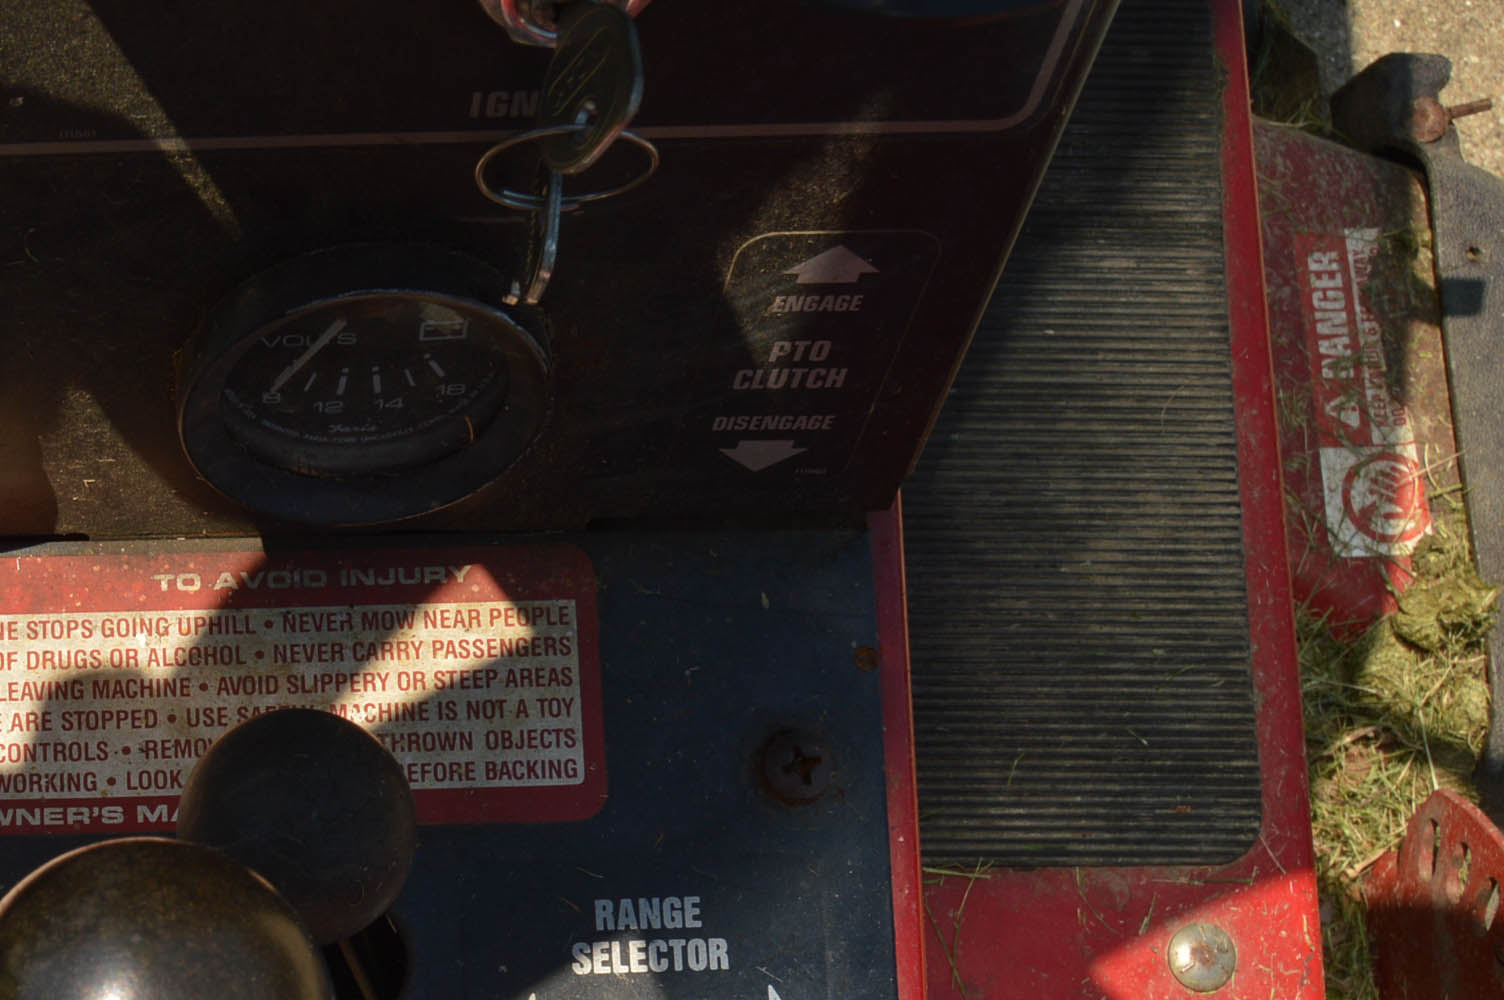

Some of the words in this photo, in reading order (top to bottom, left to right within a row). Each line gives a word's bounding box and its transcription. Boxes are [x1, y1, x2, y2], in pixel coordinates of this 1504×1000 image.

[772, 293, 864, 312] ENGAGE
[1307, 250, 1355, 379] DANGER
[768, 340, 832, 363] PTO
[732, 368, 848, 390] CLUTCH
[313, 401, 344, 413] 12
[373, 398, 404, 410] 14
[712, 415, 838, 431] DISENGAGE
[154, 572, 200, 591] TO
[213, 569, 326, 591] AVOID
[340, 565, 472, 587] INJURY
[26, 619, 94, 641] STOPS
[101, 616, 171, 638] GOING
[178, 615, 256, 637] UPHILL
[282, 610, 353, 633] NEVER
[362, 610, 415, 632] MOW
[423, 608, 481, 630] NEAR
[489, 605, 570, 628] PEOPLE
[26, 648, 102, 671] DRUGS
[110, 648, 139, 669] OR
[147, 645, 248, 668] ALCOHOL
[272, 641, 345, 664] NEVER
[353, 640, 424, 661] CARRY
[432, 636, 572, 660] PASSENGERS
[92, 677, 191, 700] MACHINE
[217, 675, 279, 697] AVOID
[286, 671, 390, 695] SLIPPERY
[397, 670, 426, 692] OR
[434, 668, 499, 690] STEEP
[505, 667, 573, 689] AREAS
[10, 711, 52, 733] ARE
[61, 708, 158, 732] STOPPED
[186, 706, 228, 728] USE
[329, 701, 429, 724] MACHINE
[438, 700, 457, 721] IS
[467, 699, 507, 720] NOT
[515, 698, 529, 719] A
[536, 696, 574, 718] TOY
[380, 731, 473, 753] THROWN
[486, 728, 577, 750] OBJECTS
[126, 768, 183, 791] LOOK
[485, 758, 578, 781] BACKING
[595, 896, 703, 931] RANGE
[571, 937, 730, 975] SELECTOR
